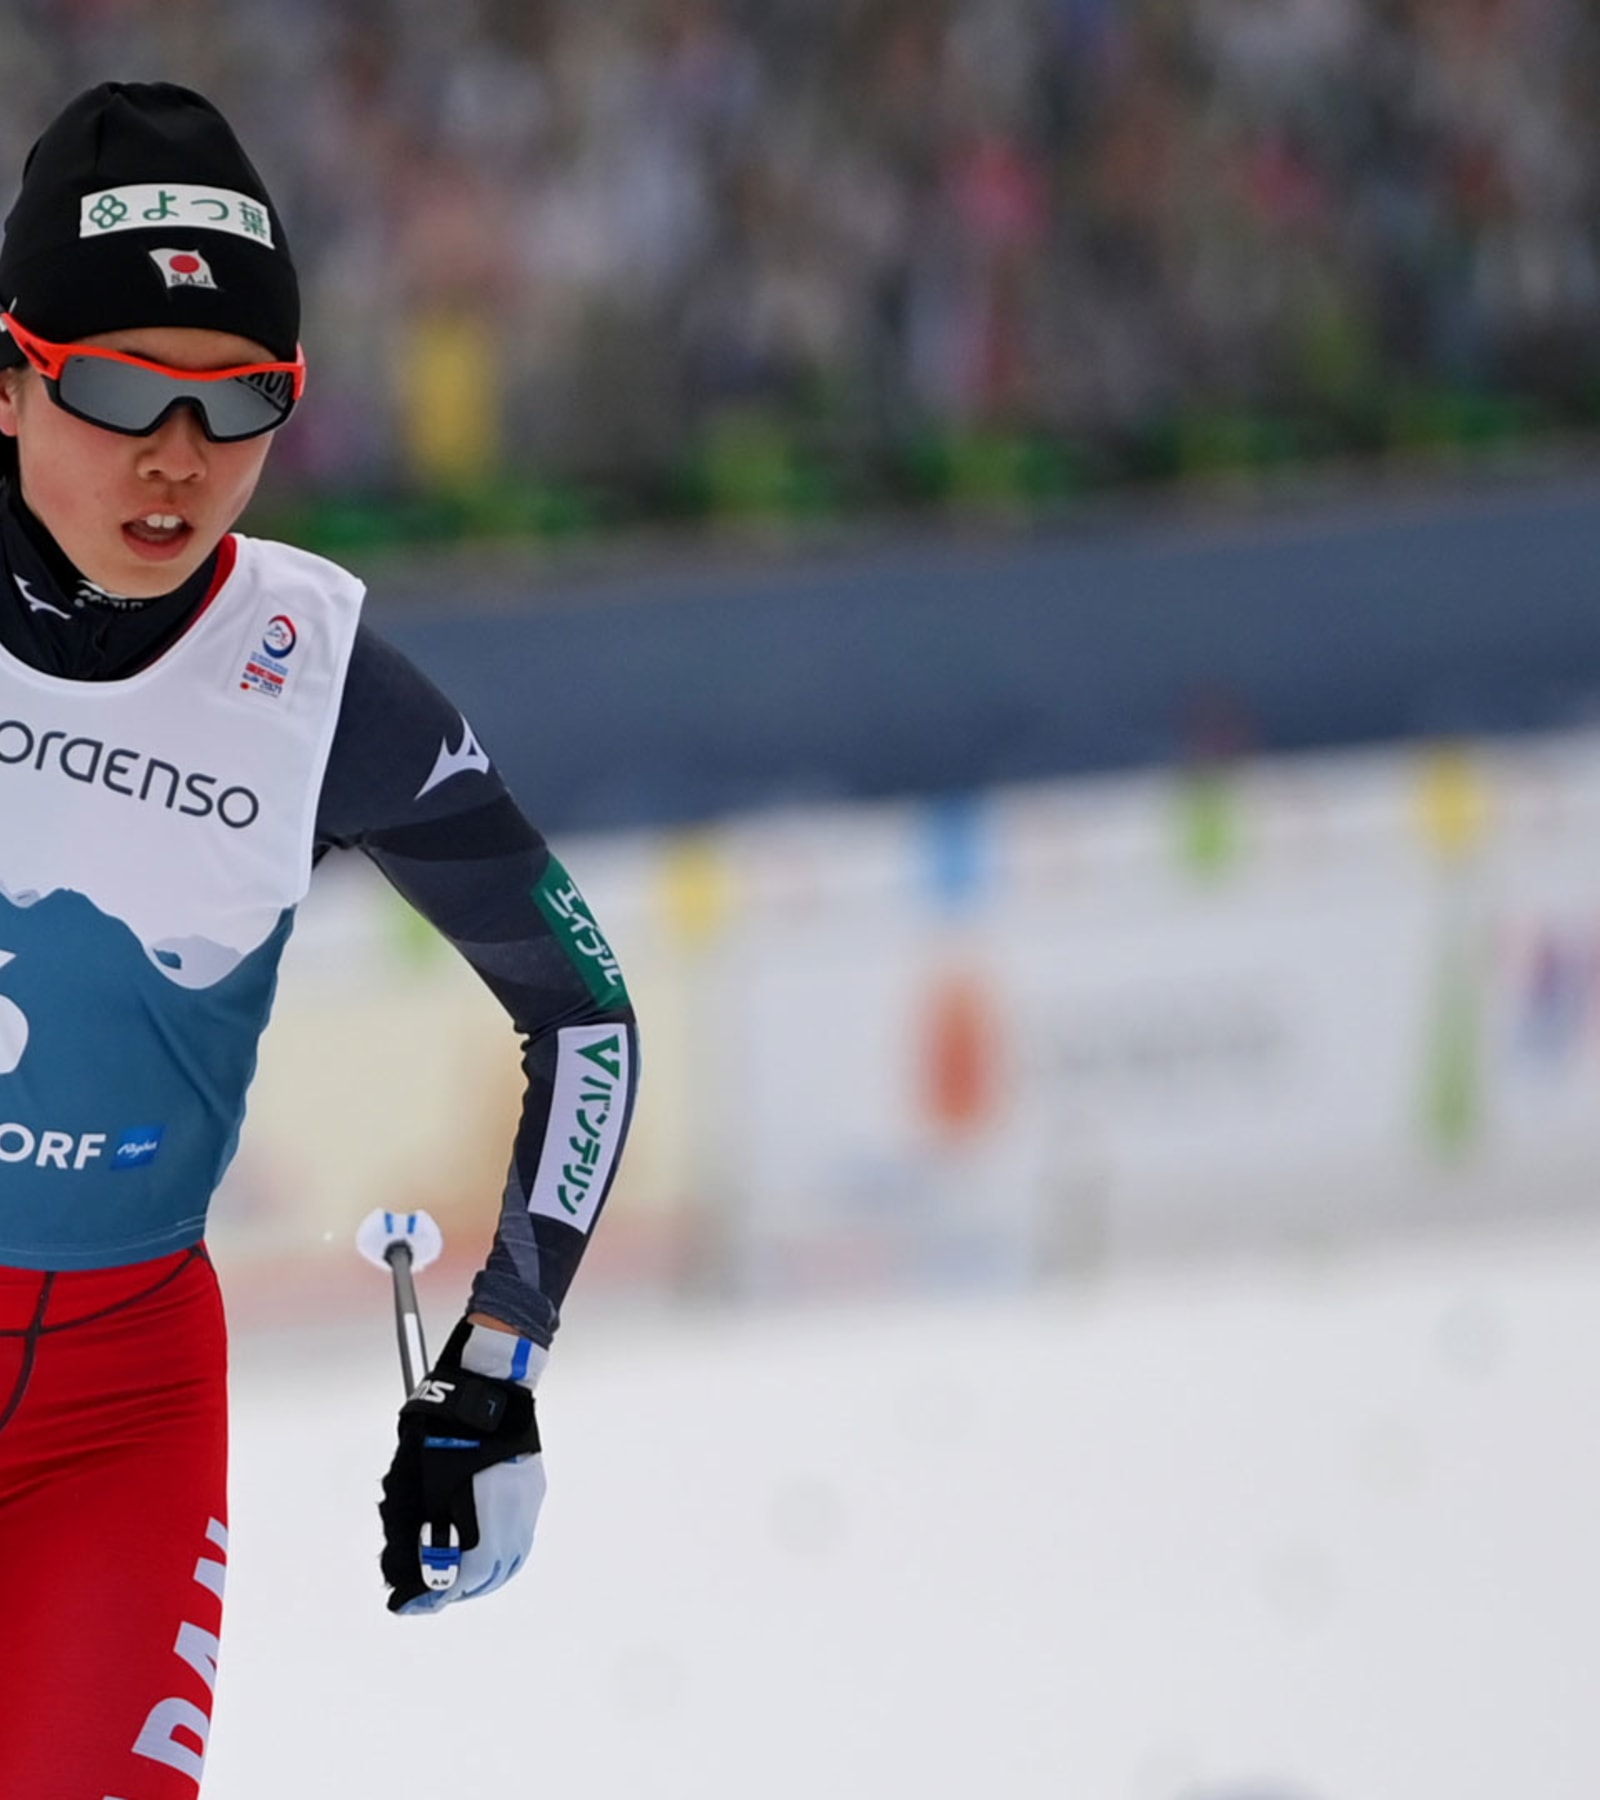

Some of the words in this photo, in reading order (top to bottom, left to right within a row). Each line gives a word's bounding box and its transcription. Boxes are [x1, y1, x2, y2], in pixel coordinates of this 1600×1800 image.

[142, 189, 268, 239] よつ葉
[555, 879, 622, 987] エイブル
